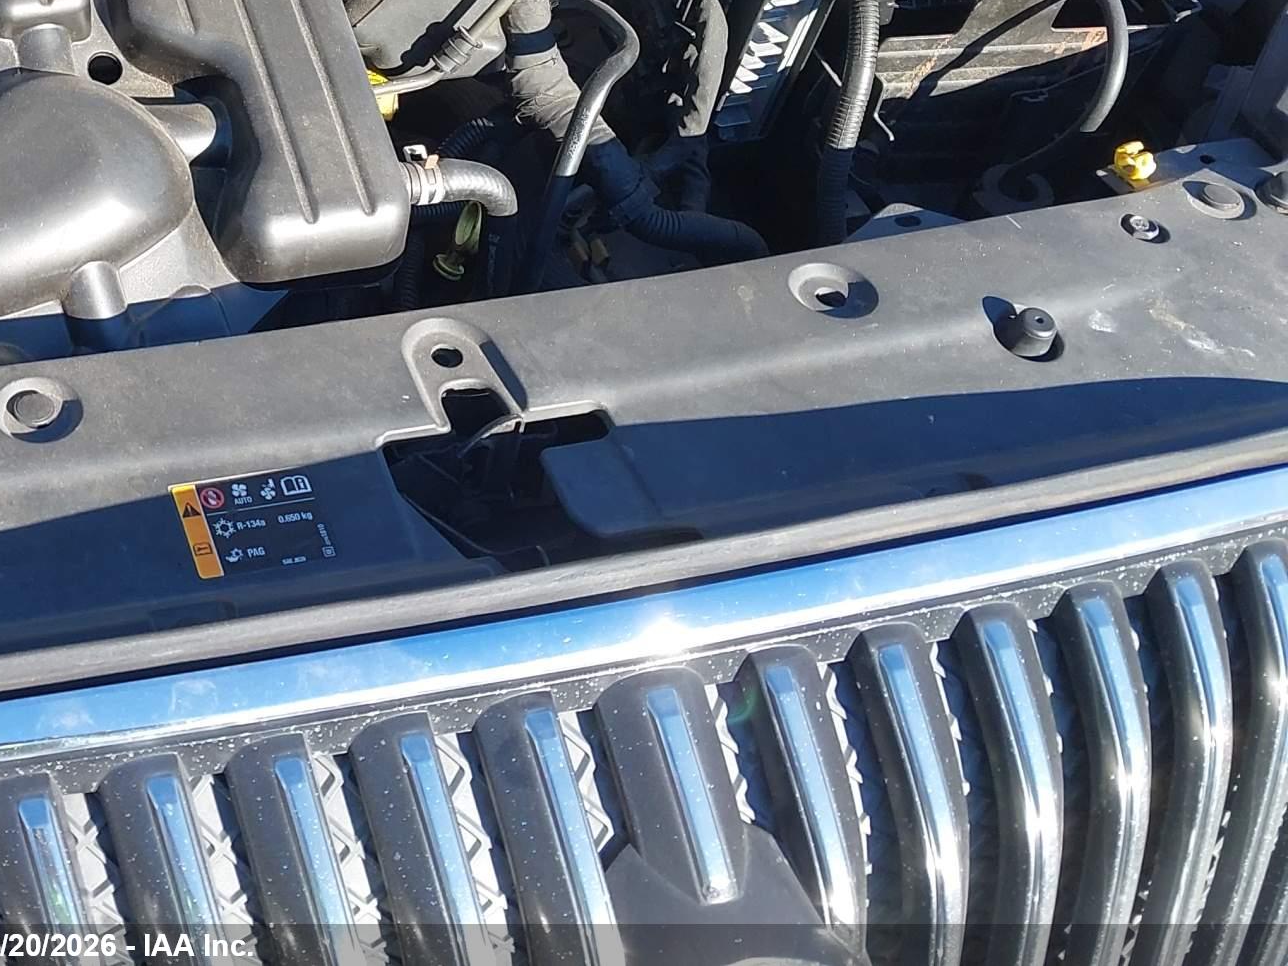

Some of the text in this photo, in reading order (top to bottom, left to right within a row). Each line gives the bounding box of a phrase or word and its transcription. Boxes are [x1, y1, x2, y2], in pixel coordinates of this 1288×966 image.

[234, 496, 253, 505] AUTO
[236, 519, 266, 531] R-134a
[301, 512, 313, 521] kg
[247, 547, 266, 559] PAG
